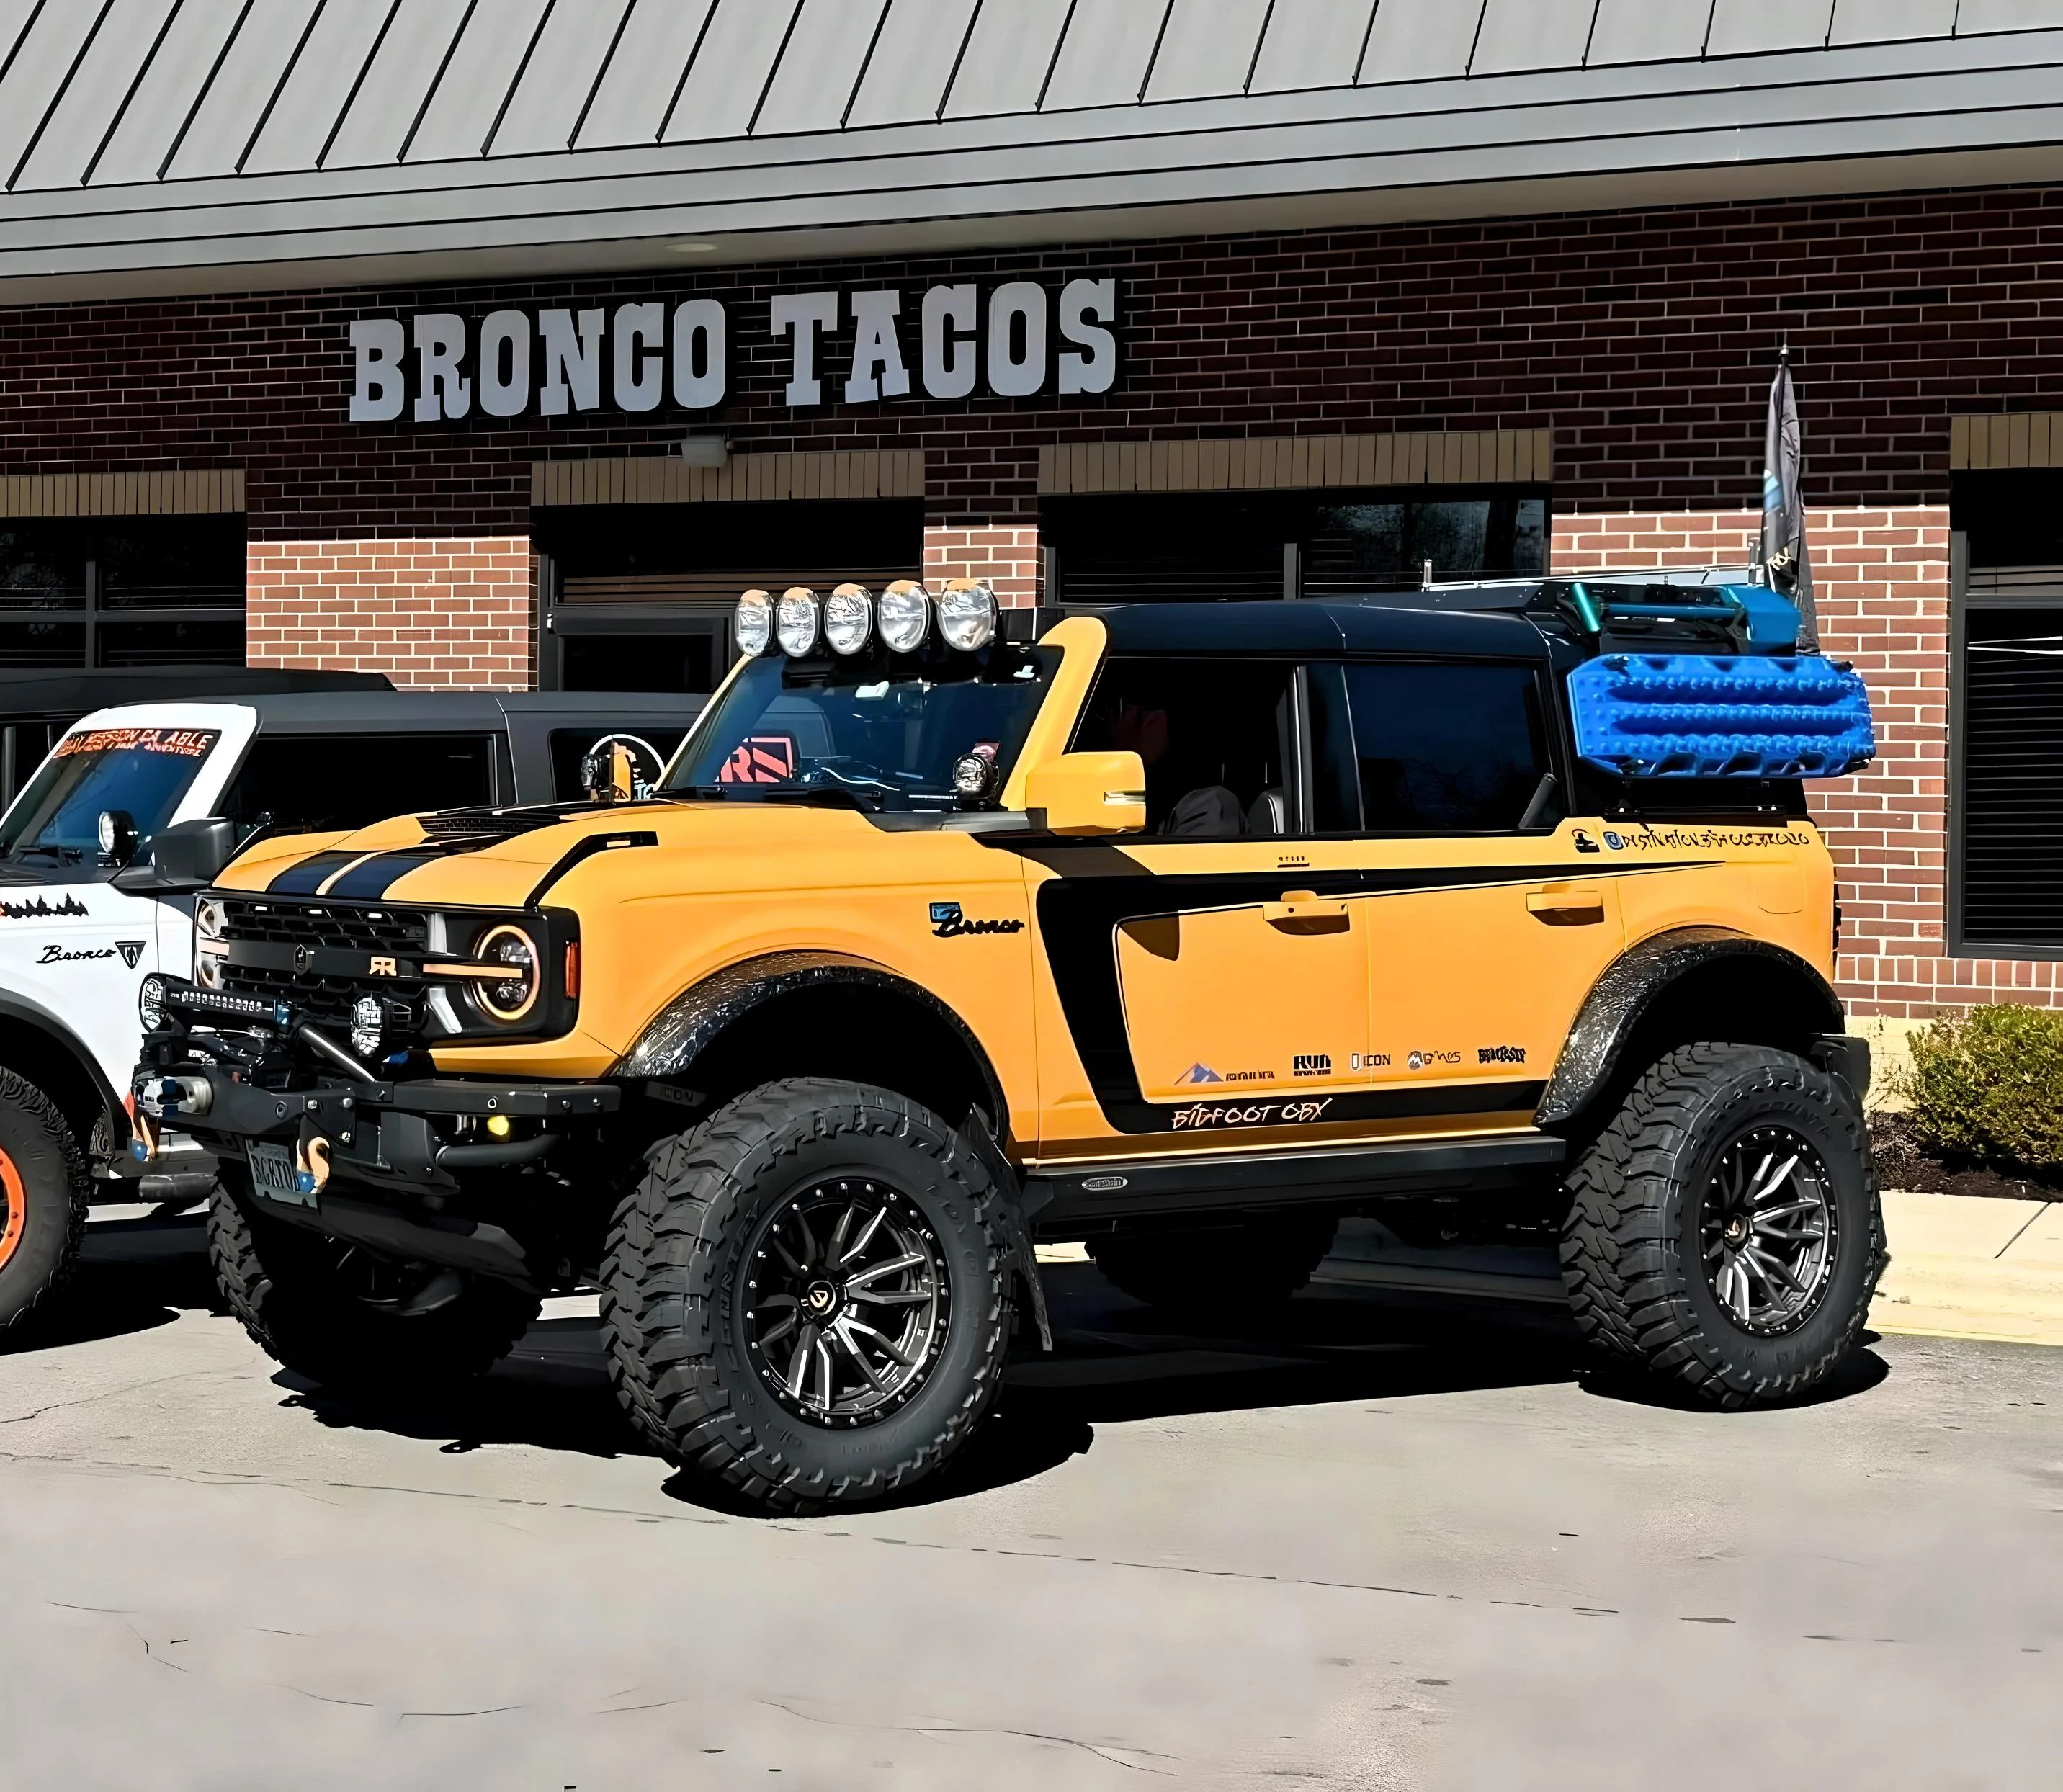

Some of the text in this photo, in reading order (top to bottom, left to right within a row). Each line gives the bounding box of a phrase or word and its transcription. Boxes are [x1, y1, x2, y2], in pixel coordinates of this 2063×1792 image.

[349, 279, 1116, 422] BRONCO TACOS
[932, 909, 1025, 938] Bronco
[35, 944, 117, 964] Bronco
[1281, 1097, 1333, 1122] OBX
